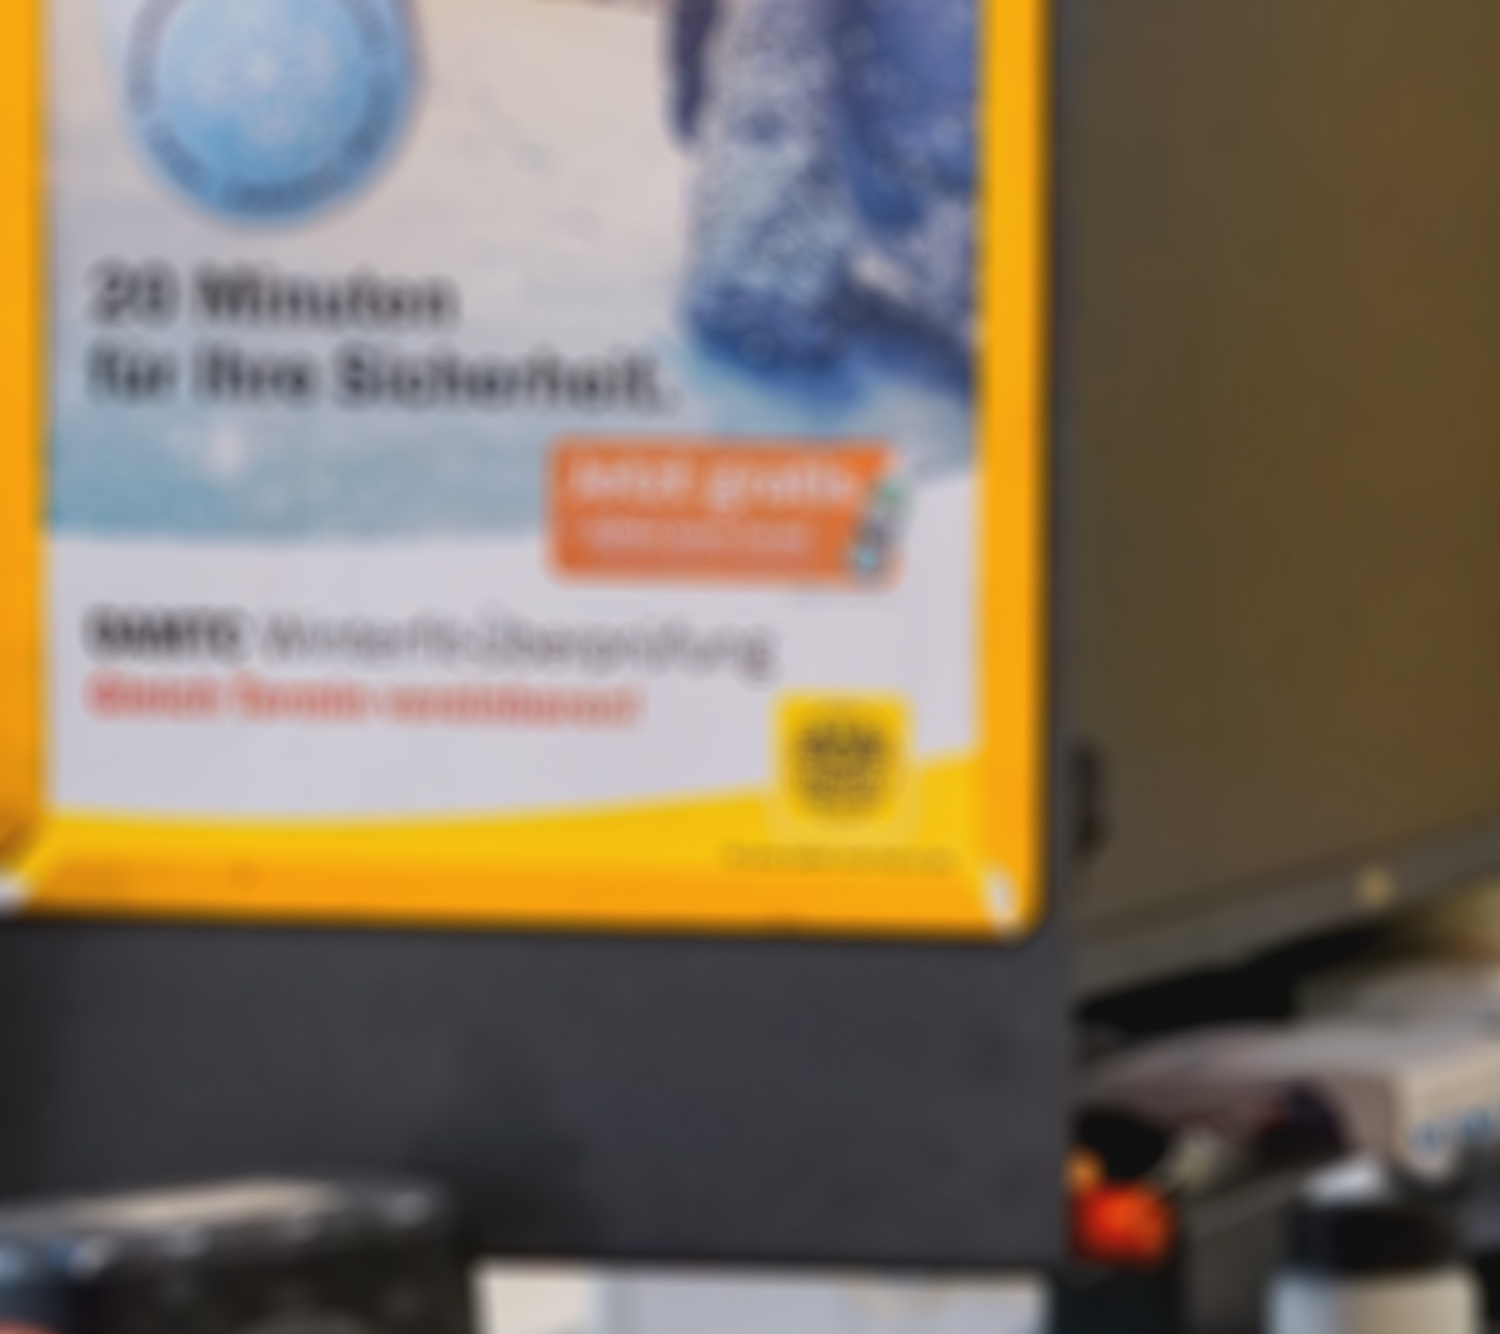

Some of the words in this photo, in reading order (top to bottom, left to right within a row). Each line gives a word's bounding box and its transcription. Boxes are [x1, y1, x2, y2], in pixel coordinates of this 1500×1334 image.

[197, 267, 460, 330] Minuten
[89, 343, 178, 406] für
[200, 347, 319, 407] Ihre
[333, 347, 678, 412] Sicherheit.
